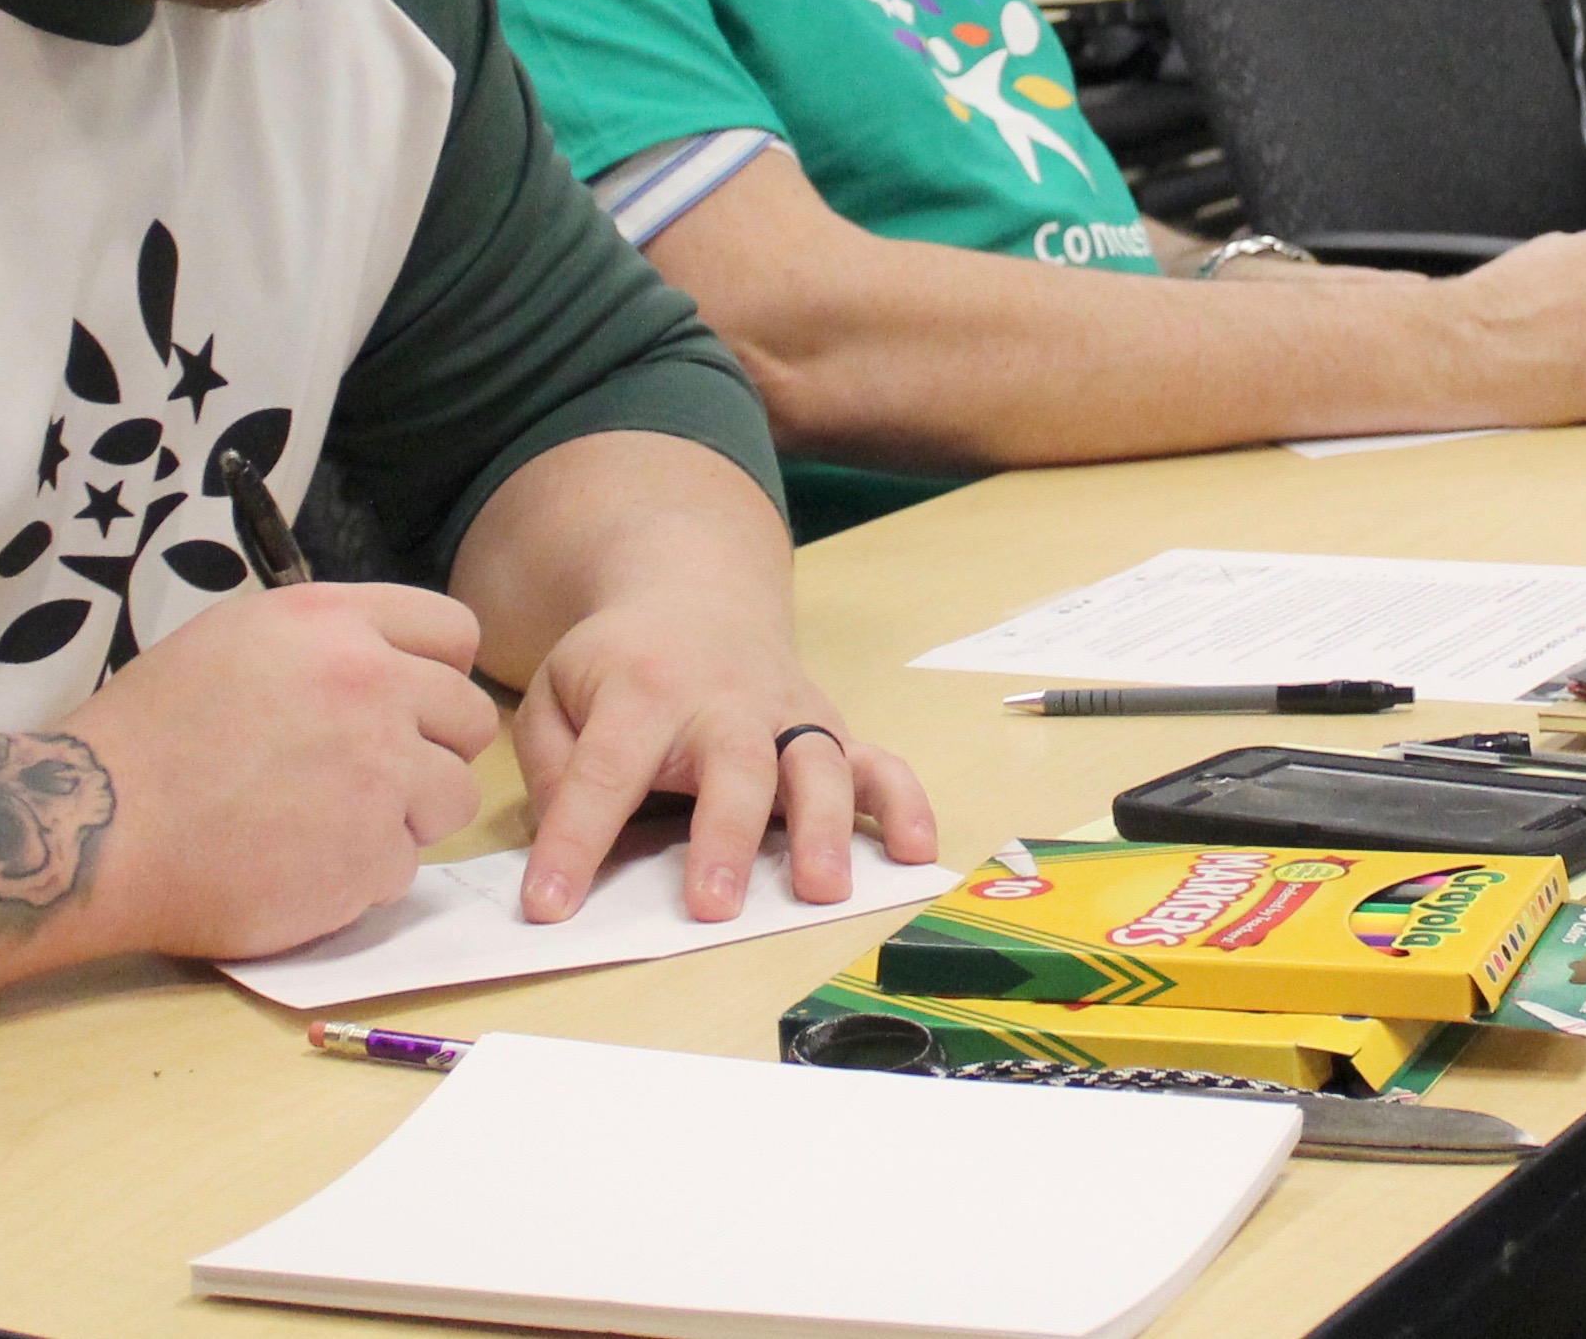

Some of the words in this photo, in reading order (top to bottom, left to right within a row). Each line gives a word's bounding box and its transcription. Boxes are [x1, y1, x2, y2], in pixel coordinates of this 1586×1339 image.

[982, 879, 1044, 899] 10
[1110, 852, 1270, 947] MARKERS
[1398, 870, 1507, 947] Crayola
